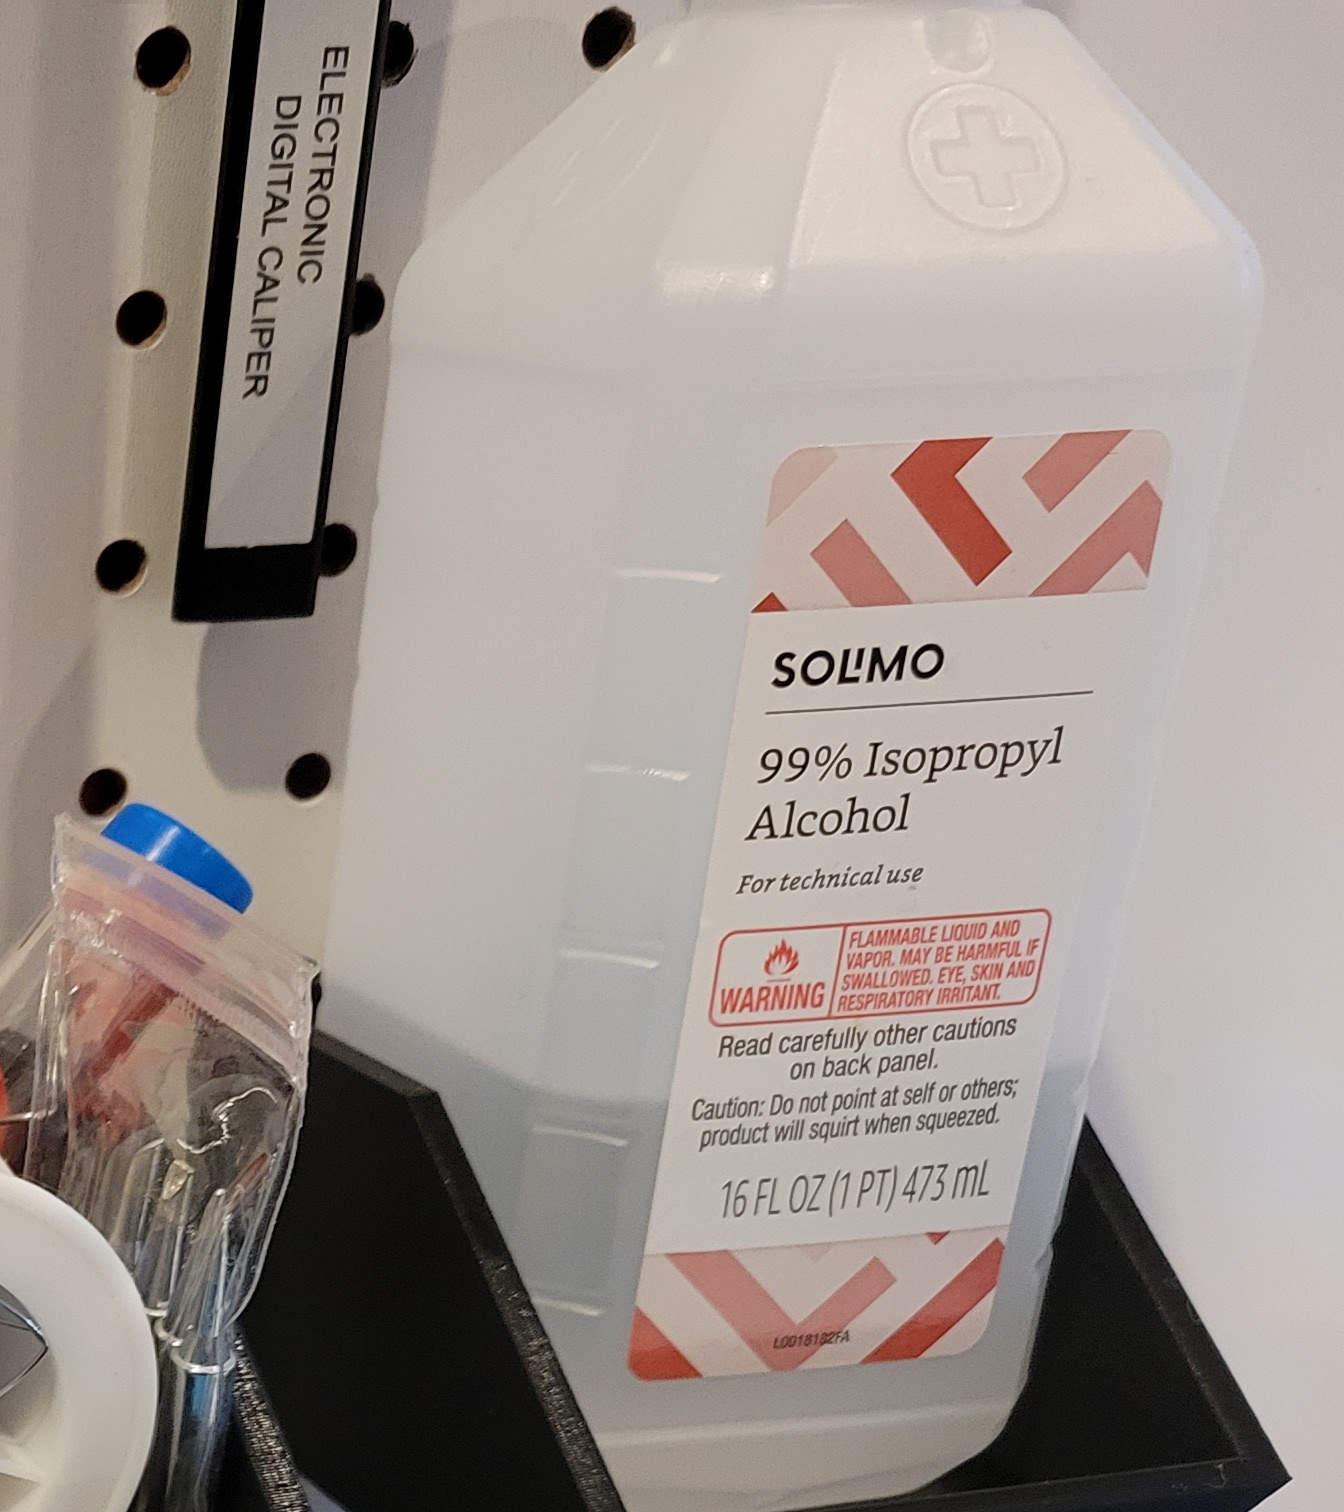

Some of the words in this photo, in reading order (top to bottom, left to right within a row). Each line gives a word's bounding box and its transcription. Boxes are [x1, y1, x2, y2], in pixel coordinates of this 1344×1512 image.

[262, 95, 302, 237] DIGITAL
[297, 46, 350, 284] ELECTRONIC
[242, 246, 284, 399] CALIPER
[771, 643, 945, 688] SOLIMO
[757, 743, 853, 784] 99%
[864, 725, 1065, 784] Isopropyl
[744, 793, 911, 842] Alcohol
[735, 874, 777, 896] For
[779, 864, 884, 892] technical
[886, 866, 924, 885] use
[846, 950, 895, 970] VAPOR.
[899, 947, 932, 965] MAY
[934, 945, 957, 964] BE
[956, 941, 1022, 962] HARMFUL
[1026, 938, 1040, 956] IF
[849, 926, 938, 949] FLAMMABLE
[941, 922, 987, 942] LIQUID
[990, 919, 1021, 938] AND
[841, 968, 932, 991] SWALLOWED.
[937, 966, 967, 985] EYE,
[970, 962, 1003, 982] SKIN
[1006, 960, 1036, 979] AND
[720, 982, 825, 1014] WARNING
[837, 988, 934, 1013] RESPIRATORY
[936, 983, 1002, 1005] IRRITANT.
[718, 1032, 773, 1058] Read
[778, 1026, 868, 1054] carefully
[873, 1023, 928, 1047] other
[932, 1016, 1017, 1043] cautions
[790, 1061, 815, 1080] on
[822, 1053, 872, 1078] back
[877, 1047, 938, 1079] panel.
[691, 1096, 766, 1121] Caution:
[769, 1094, 794, 1116] Do
[798, 1091, 828, 1114] not
[831, 1087, 877, 1116] point
[880, 1085, 899, 1107] at
[902, 1081, 937, 1106] self
[938, 1084, 958, 1103] or
[960, 1077, 1019, 1101] others;
[699, 1122, 770, 1152] product
[774, 1119, 805, 1142] will
[808, 1114, 860, 1144] squirt
[864, 1112, 911, 1135] when
[915, 1102, 1000, 1135] squeezed.
[721, 1179, 749, 1218] 16
[753, 1177, 781, 1216] FL
[789, 1173, 826, 1214] OZ
[828, 1169, 852, 1217] (1
[856, 1164, 898, 1213] PT)
[901, 1163, 949, 1203] 473
[951, 1158, 990, 1200] mL
